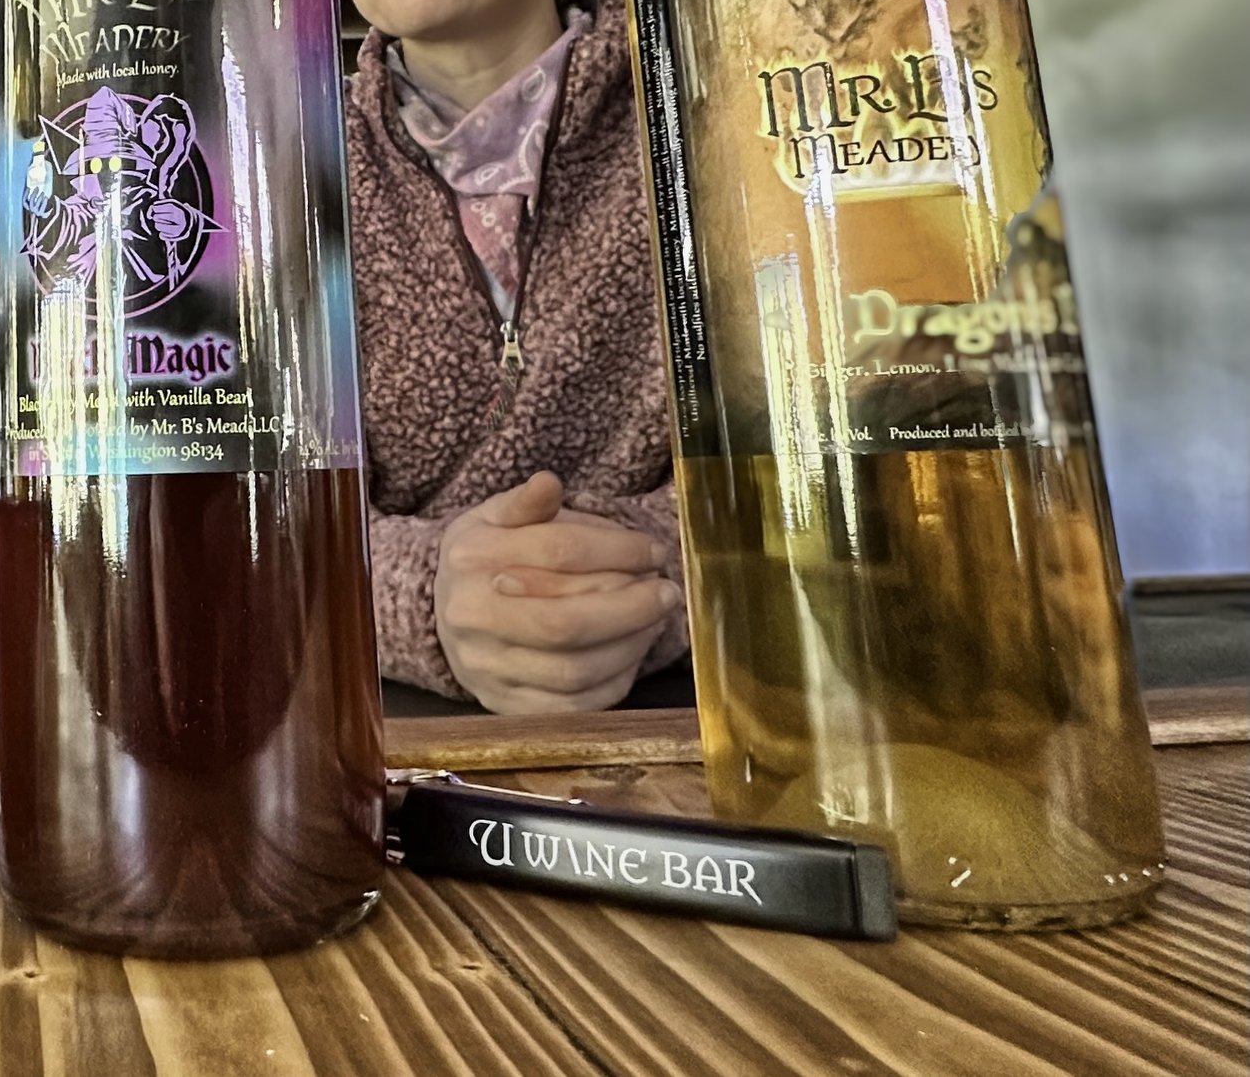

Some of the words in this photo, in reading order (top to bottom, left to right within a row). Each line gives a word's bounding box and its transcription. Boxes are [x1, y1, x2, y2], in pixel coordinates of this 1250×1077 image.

[57, 67, 85, 88] Made
[86, 62, 110, 80] with
[112, 59, 140, 77] local
[790, 133, 982, 179] MEADEY
[661, 157, 673, 186] small
[667, 202, 678, 232] Made
[127, 334, 233, 383] Magic
[124, 387, 156, 408] with
[158, 386, 212, 407] Vanilla
[130, 417, 149, 441] by
[151, 418, 178, 436] Mr.
[181, 417, 203, 435] B's
[206, 415, 248, 434] Mead
[251, 416, 281, 433] LLC
[889, 423, 951, 440] Produced
[953, 423, 978, 439] and
[86, 440, 177, 463] Wshington
[180, 444, 225, 462] 98134
[659, 849, 763, 907] BAR
